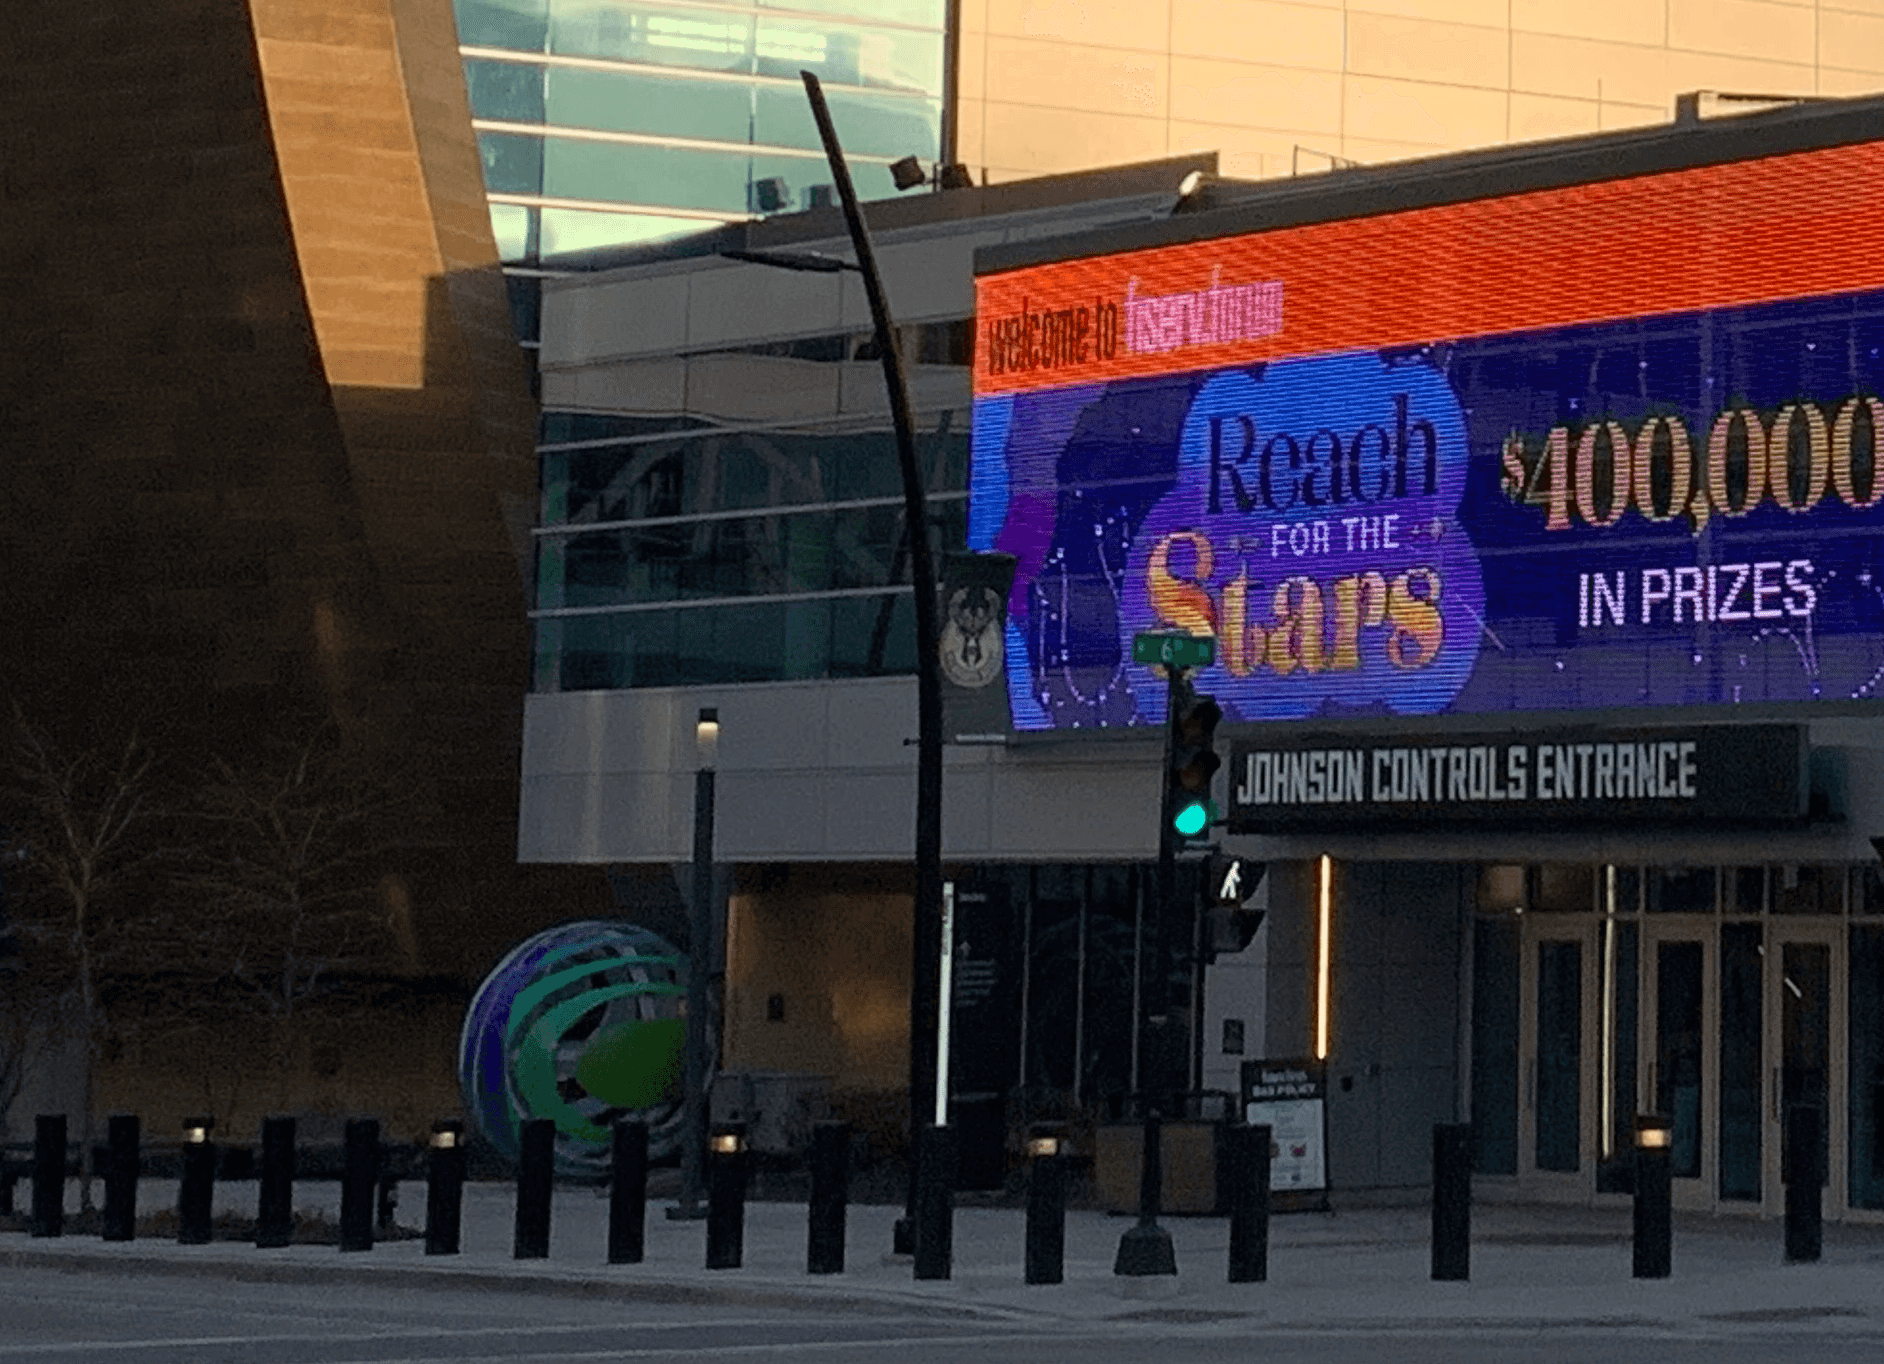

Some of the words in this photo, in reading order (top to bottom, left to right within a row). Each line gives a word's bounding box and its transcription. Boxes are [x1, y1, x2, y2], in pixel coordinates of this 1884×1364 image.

[989, 296, 1090, 376] welcome
[1096, 295, 1117, 361] to
[1207, 392, 1439, 514] Reach
[1271, 520, 1330, 558] FOR
[1341, 513, 1400, 552] THE
[1148, 530, 1443, 677] Stars
[1579, 570, 1626, 628] IN
[1642, 559, 1817, 624] PRIZES
[1237, 749, 1364, 805] JOHNSON
[1371, 745, 1527, 803] CONTROLS
[1536, 741, 1697, 800] ENTRANCE
